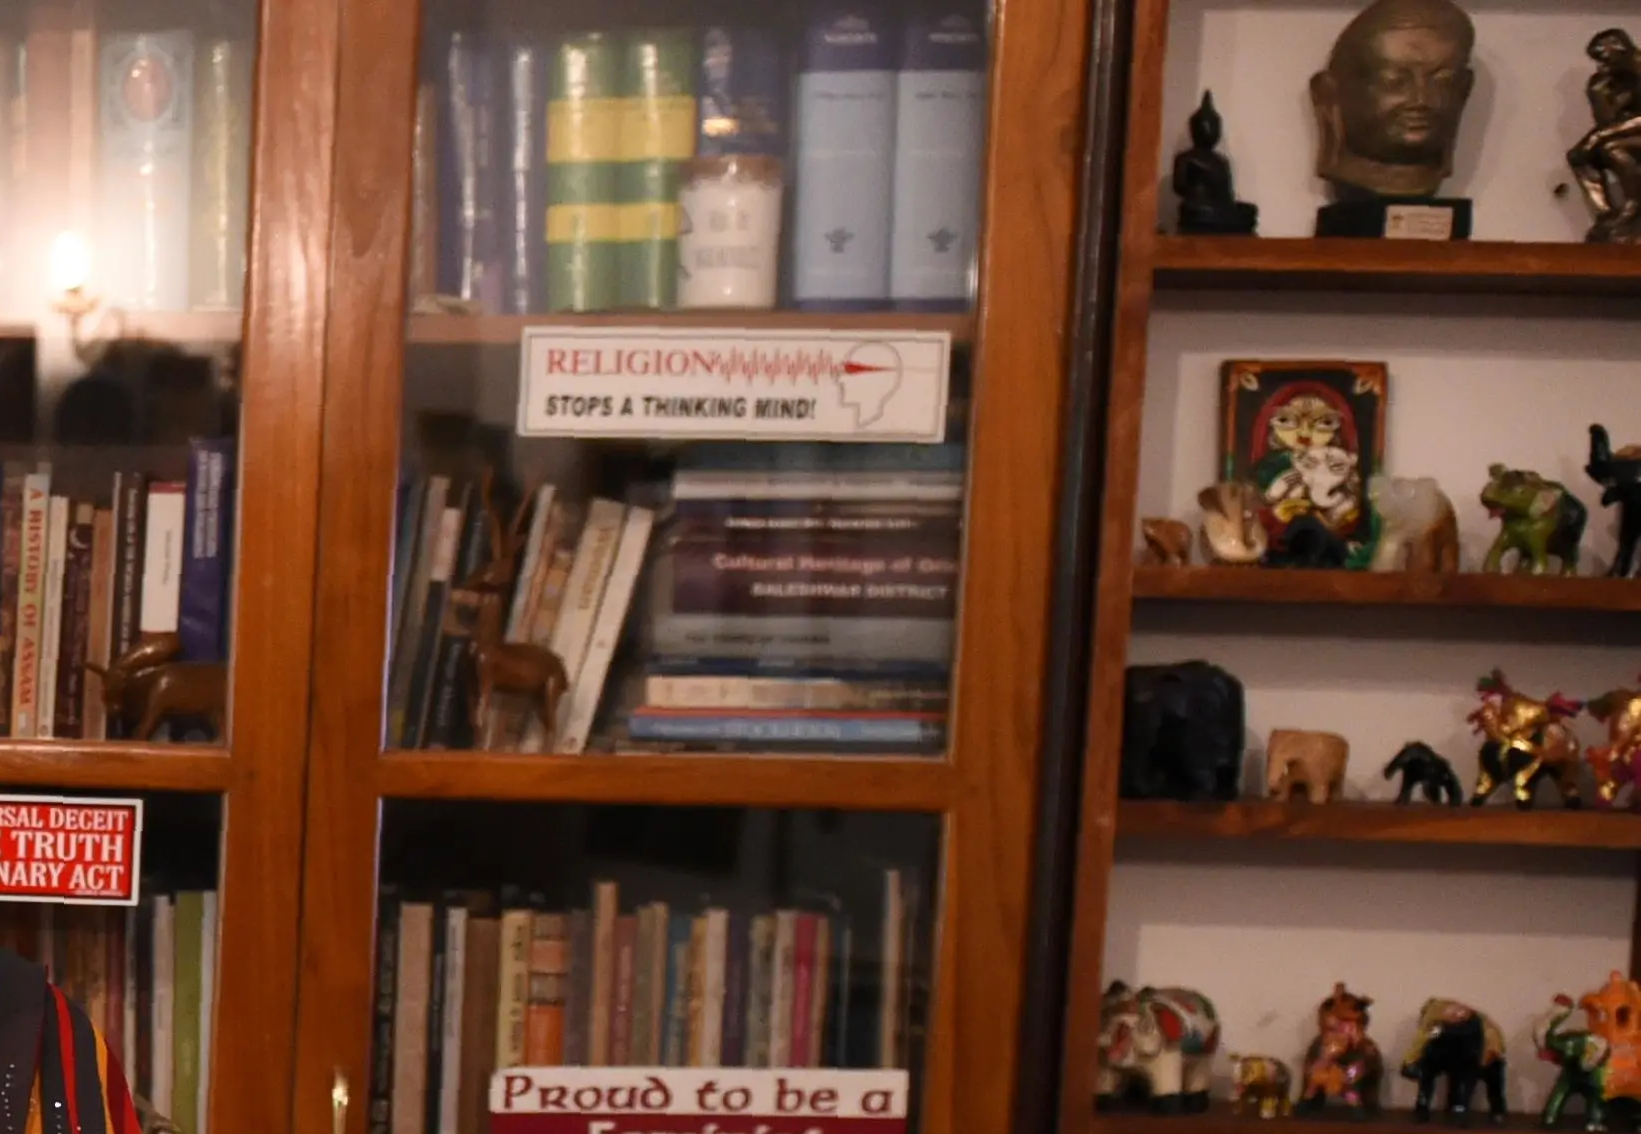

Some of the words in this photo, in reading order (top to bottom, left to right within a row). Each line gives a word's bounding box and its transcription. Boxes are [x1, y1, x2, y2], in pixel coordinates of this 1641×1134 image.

[545, 349, 714, 376] RELIGION
[545, 395, 613, 417] STOPS
[619, 396, 634, 417] A
[641, 396, 747, 419] THINKING
[755, 397, 817, 420] MIND!
[29, 488, 45, 500] A
[24, 509, 44, 593] HISTORY
[22, 602, 39, 627] OF
[18, 637, 37, 706] ASSAM
[49, 806, 129, 832] DECEIT
[10, 830, 125, 863] TRUTH
[67, 863, 125, 891] ACT
[502, 1074, 674, 1111] Proud
[695, 1080, 752, 1112] to
[775, 1078, 840, 1113] be
[860, 1088, 894, 1114] a
